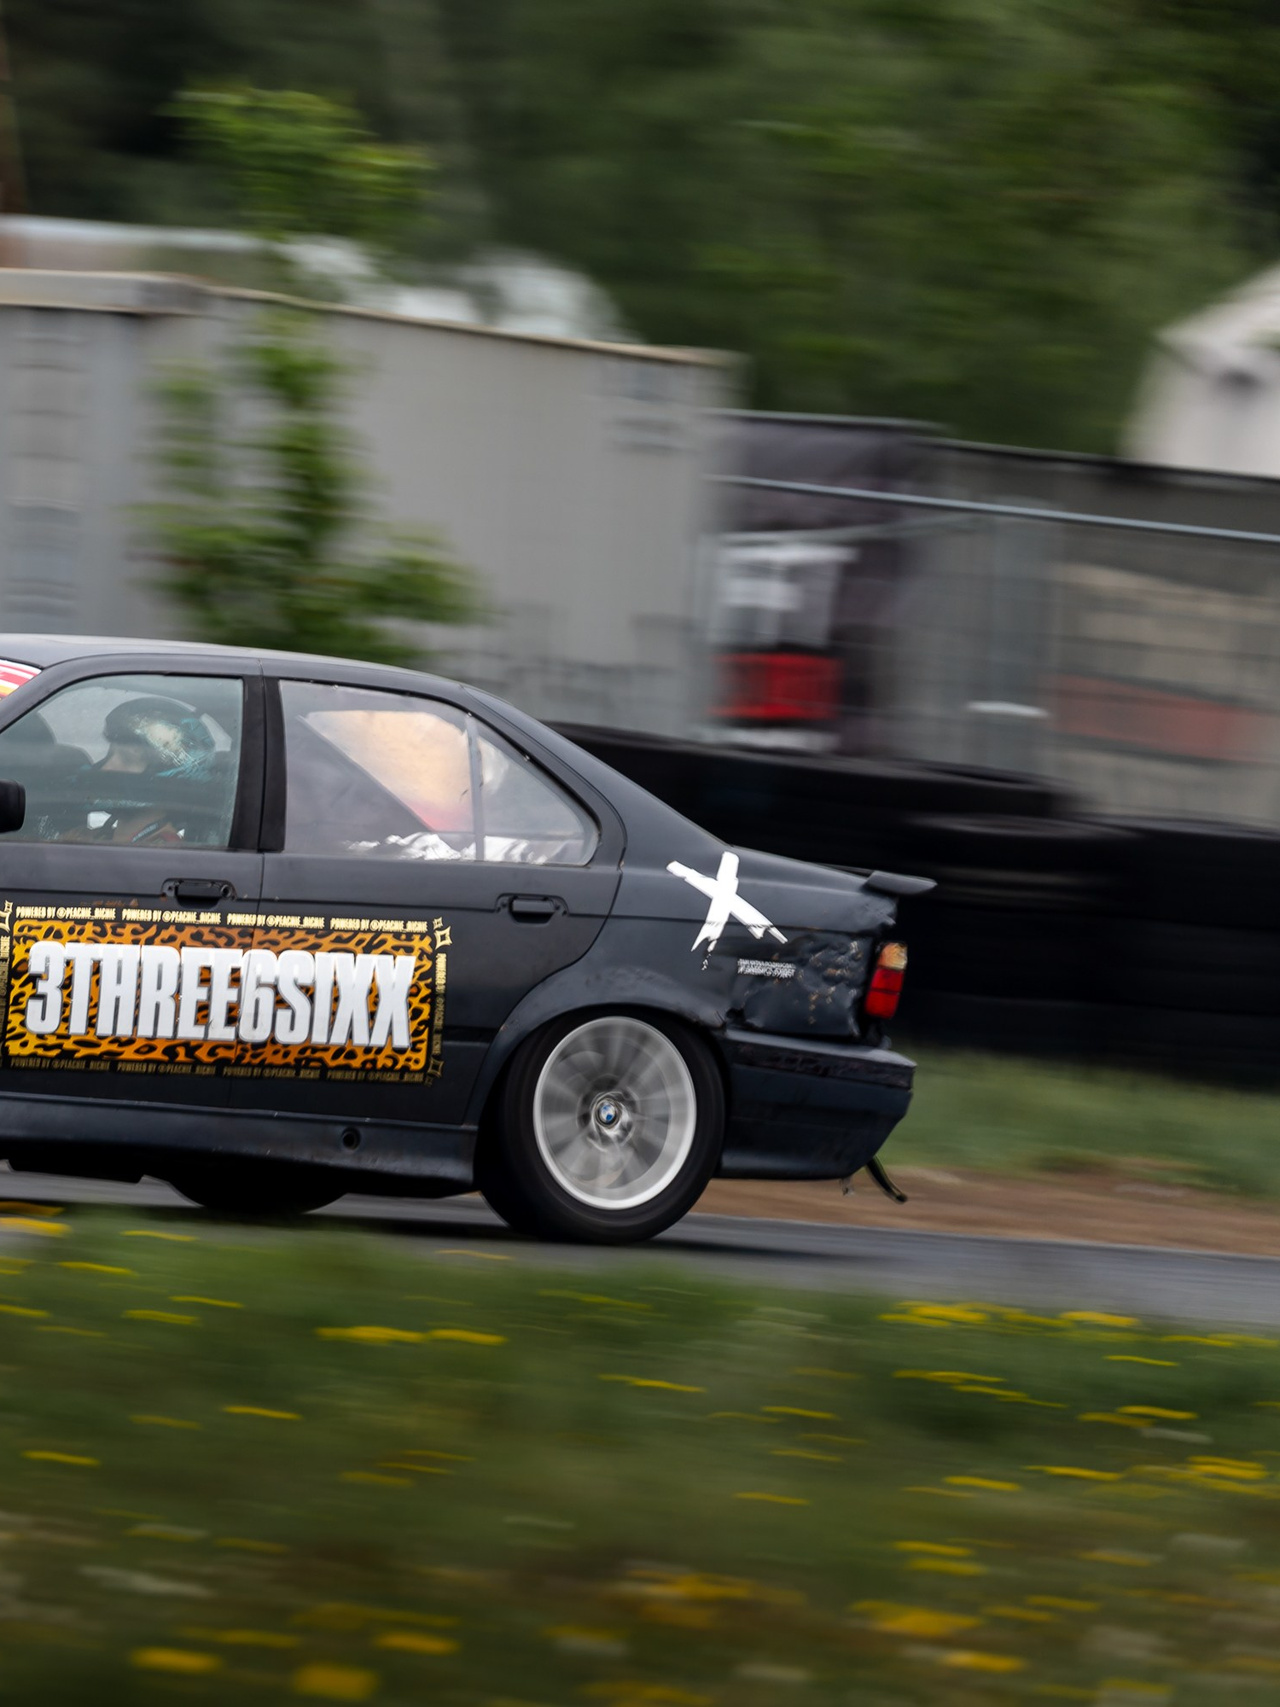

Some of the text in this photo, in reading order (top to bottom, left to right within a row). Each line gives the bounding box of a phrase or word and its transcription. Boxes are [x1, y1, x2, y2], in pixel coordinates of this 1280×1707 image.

[16, 906, 46, 918] POWERED
[46, 907, 55, 918] BY
[122, 908, 152, 921] POWERED
[152, 909, 162, 922] BY
[227, 913, 257, 927] POWERED
[257, 914, 266, 926] BY
[330, 918, 360, 930] POWERED
[361, 919, 370, 931] BY
[25, 941, 416, 1048] 3THREE6SIXX
[10, 1058, 41, 1068] POWERED
[41, 1059, 50, 1069] BY
[117, 1062, 147, 1073] POWERED
[148, 1063, 156, 1073] BY
[223, 1066, 252, 1077] POWERED
[253, 1067, 261, 1077] BY
[327, 1070, 356, 1081] POWERED
[357, 1071, 365, 1081] BY
